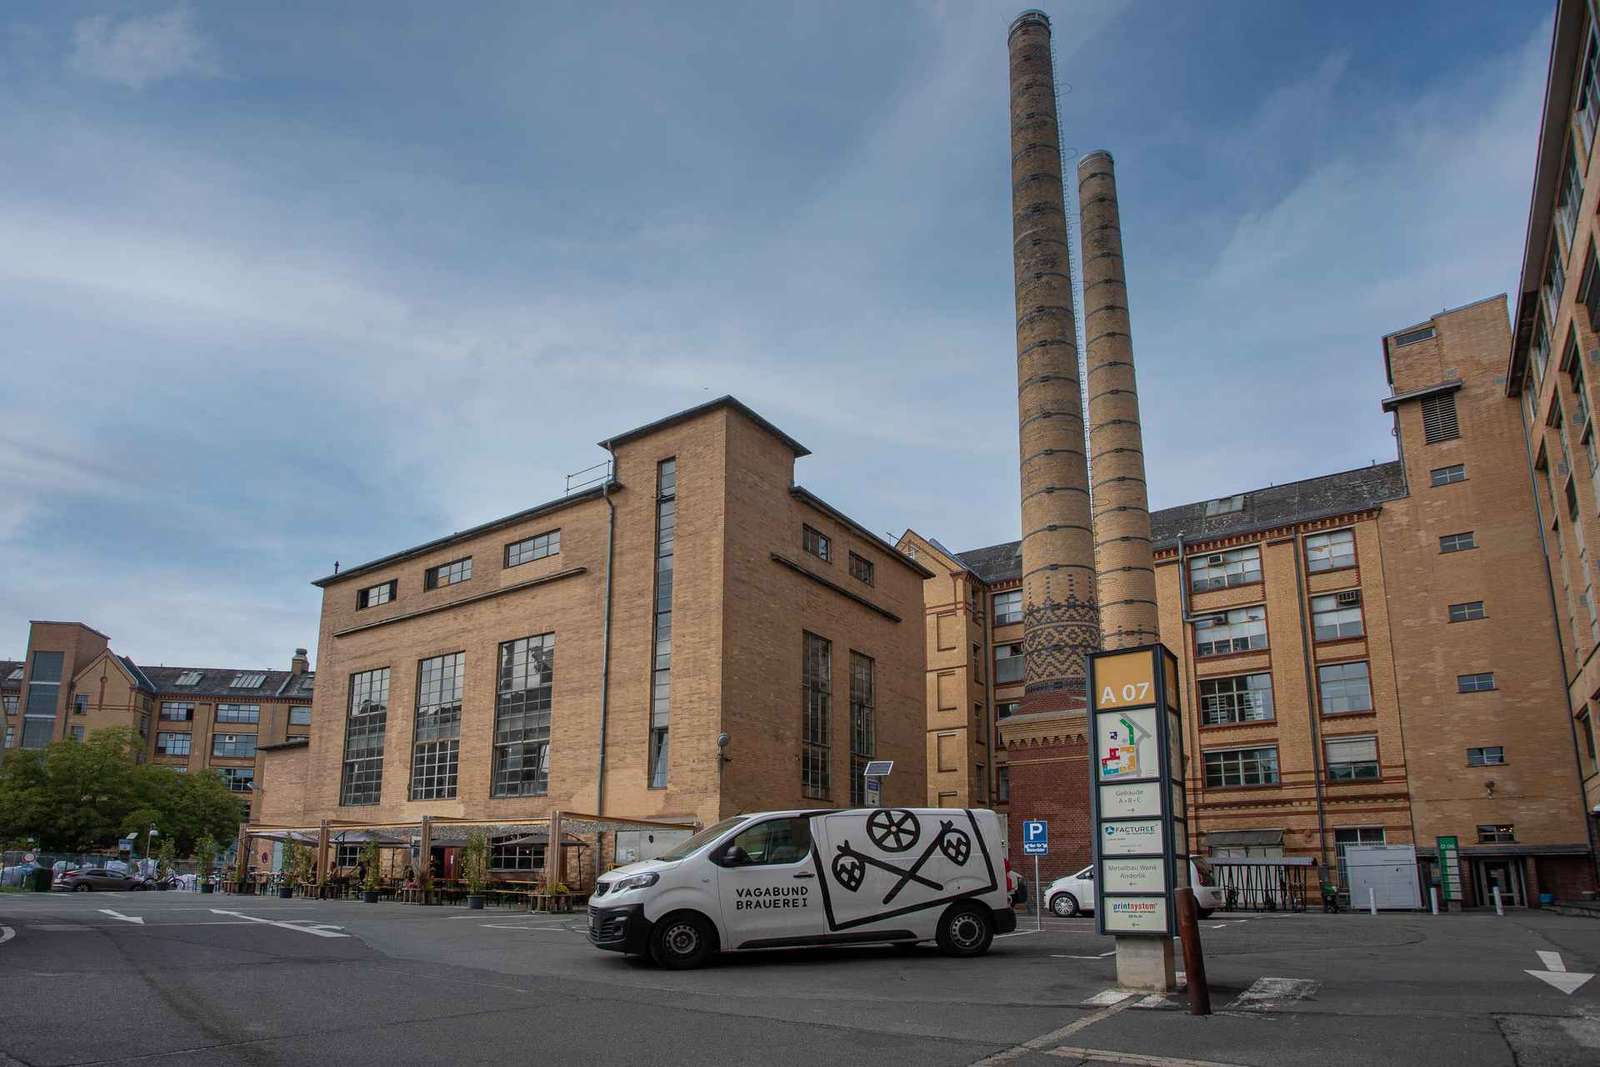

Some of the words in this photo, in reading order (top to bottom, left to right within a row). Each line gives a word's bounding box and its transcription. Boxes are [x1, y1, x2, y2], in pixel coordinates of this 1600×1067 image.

[1101, 686, 1117, 704] A
[1122, 682, 1150, 701] 07
[1030, 823, 1043, 840] P
[1115, 825, 1155, 833] FACTUREE
[736, 886, 808, 898] VAGABUND
[736, 897, 808, 910] BRAUEREI
[1113, 902, 1156, 911] printsystem
